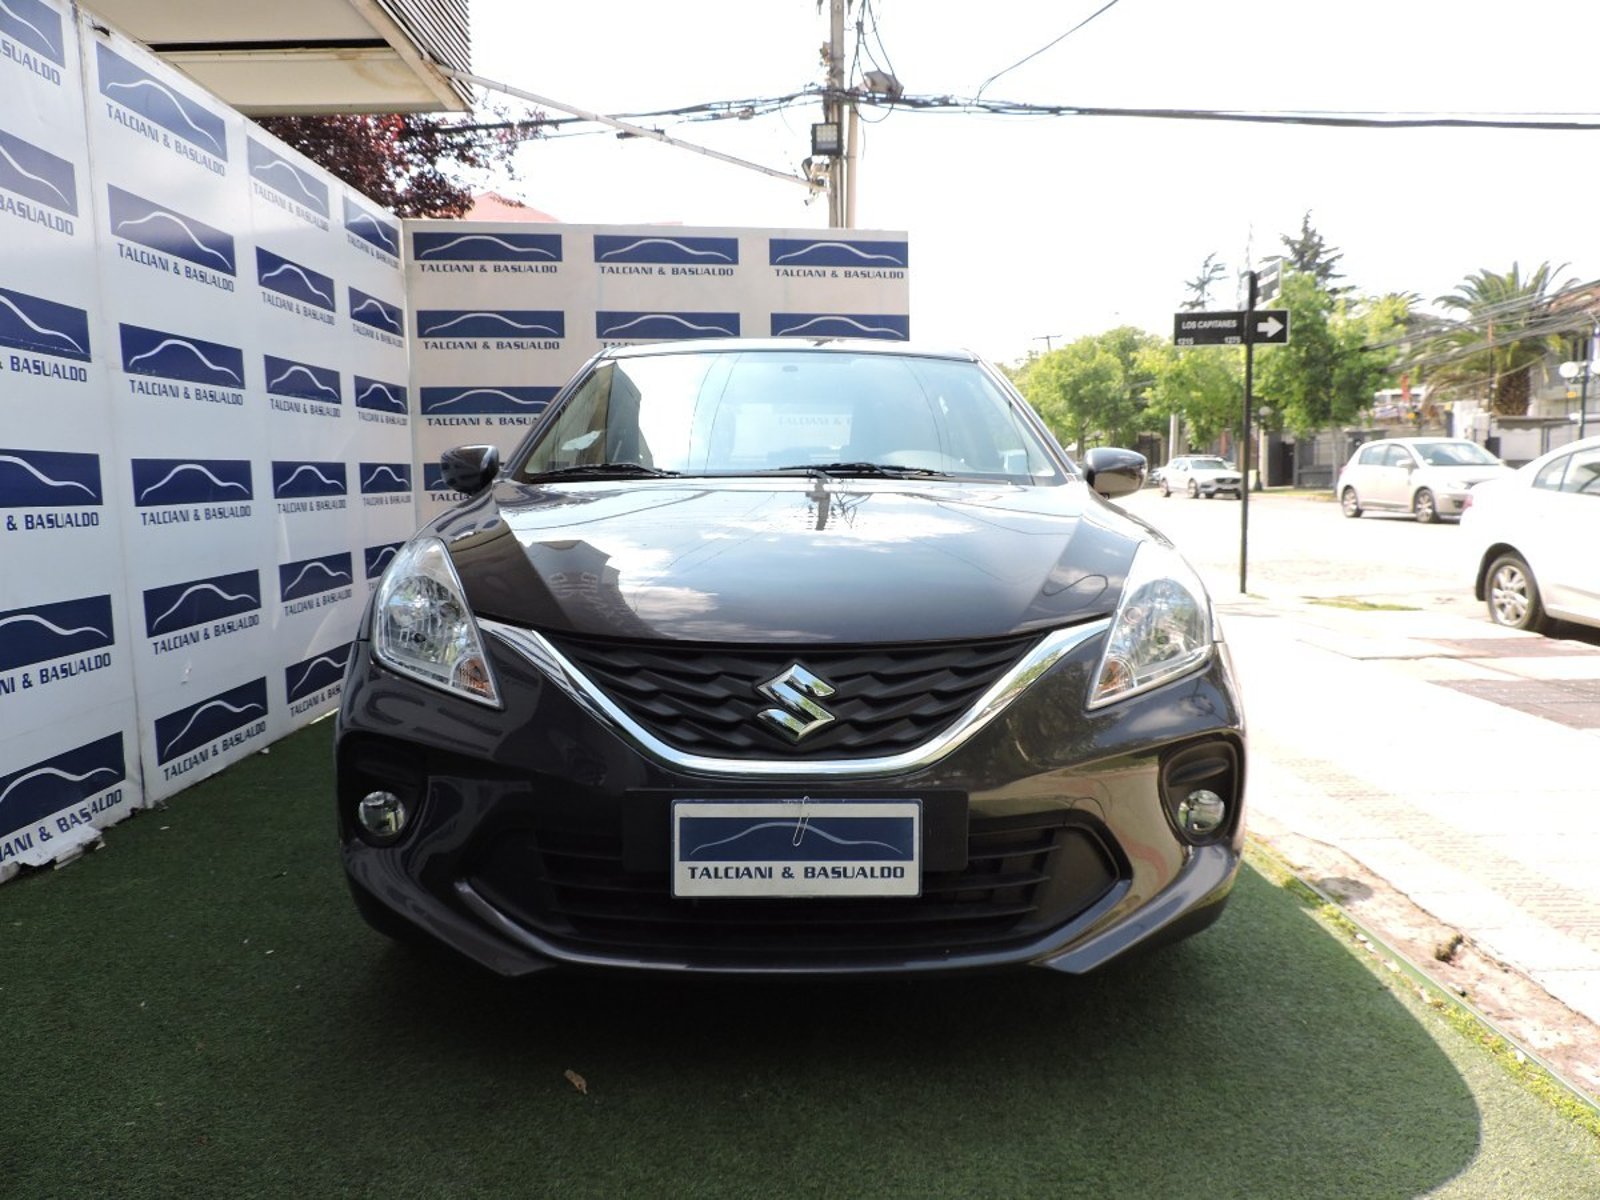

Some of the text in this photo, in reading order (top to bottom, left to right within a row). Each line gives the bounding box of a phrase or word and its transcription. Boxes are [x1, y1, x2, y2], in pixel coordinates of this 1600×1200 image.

[106, 102, 225, 177] TALCIANI & BASUALDO
[117, 243, 234, 292] TALCIANI & BASUALDO
[420, 263, 557, 274] TALCIANI & BASUALDO
[600, 266, 734, 276] TALCIANI & BASUALDO
[775, 268, 904, 279] TALCIANI & BASUALDO
[261, 291, 335, 326] TALCIANI & BASUALDO
[1182, 320, 1237, 330] LOS CAPITANES
[424, 340, 560, 350] TALCIANI & BASUALDO
[10, 355, 87, 383] BASUALDO
[129, 379, 244, 406] TALCIANI & BASUALDO
[270, 398, 341, 418] TALCIANI & BASUALDO
[427, 417, 480, 426] TALCIANI
[485, 417, 493, 426] &
[140, 505, 251, 526] TALCIANI & BASUALDO
[277, 499, 347, 514] TALCIANI & BASUALDO
[6, 512, 99, 531] & BASUALDO
[283, 589, 352, 617] TALCIANI & BASUALDO
[152, 614, 260, 655] TALCIANI & BASUALDO
[22, 673, 33, 689] &
[39, 652, 111, 685] BASUALDO
[163, 721, 266, 781] TALCIANI & BASUALDO
[38, 825, 53, 842] &
[688, 866, 905, 879] TALCIANI & BASUALDO
